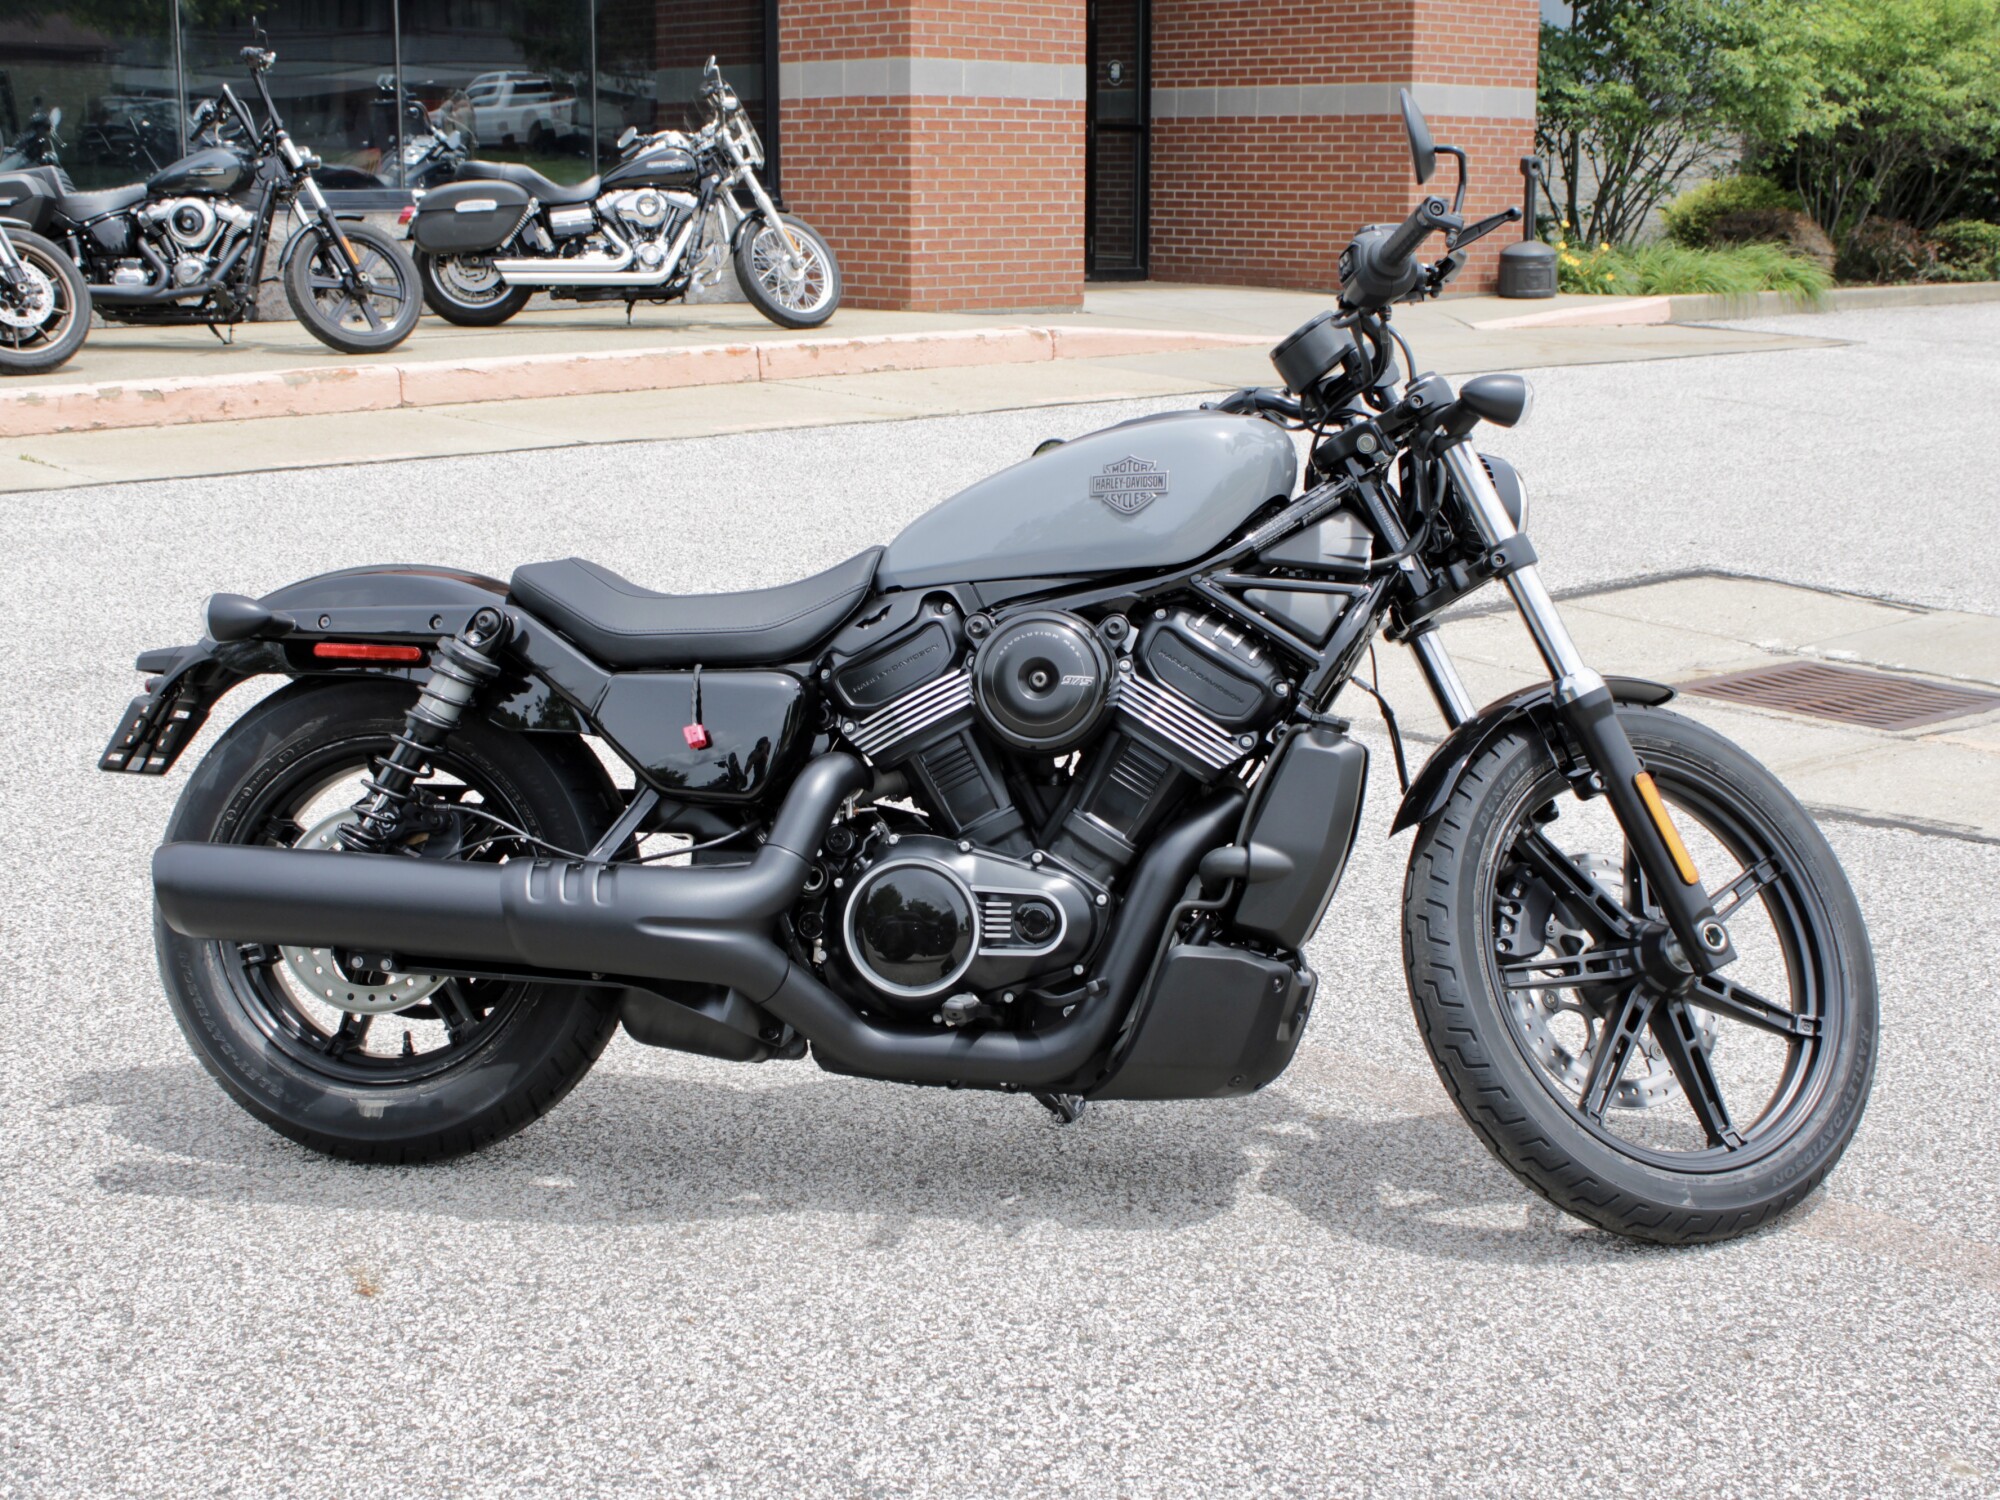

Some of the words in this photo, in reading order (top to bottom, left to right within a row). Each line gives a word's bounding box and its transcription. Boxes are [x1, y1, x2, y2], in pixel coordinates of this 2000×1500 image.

[1112, 459, 1148, 473] MOTOR
[1095, 475, 1164, 491] HARLEY-DAVIDSON
[1110, 492, 1148, 509] CYCLES
[999, 630, 1060, 656] REVOLUTION
[1063, 638, 1082, 658] MAX
[1061, 674, 1096, 687] 975
[1479, 755, 1528, 829] DUNLOP
[1771, 1026, 1871, 1187] HARLEY-DAVIDSON
